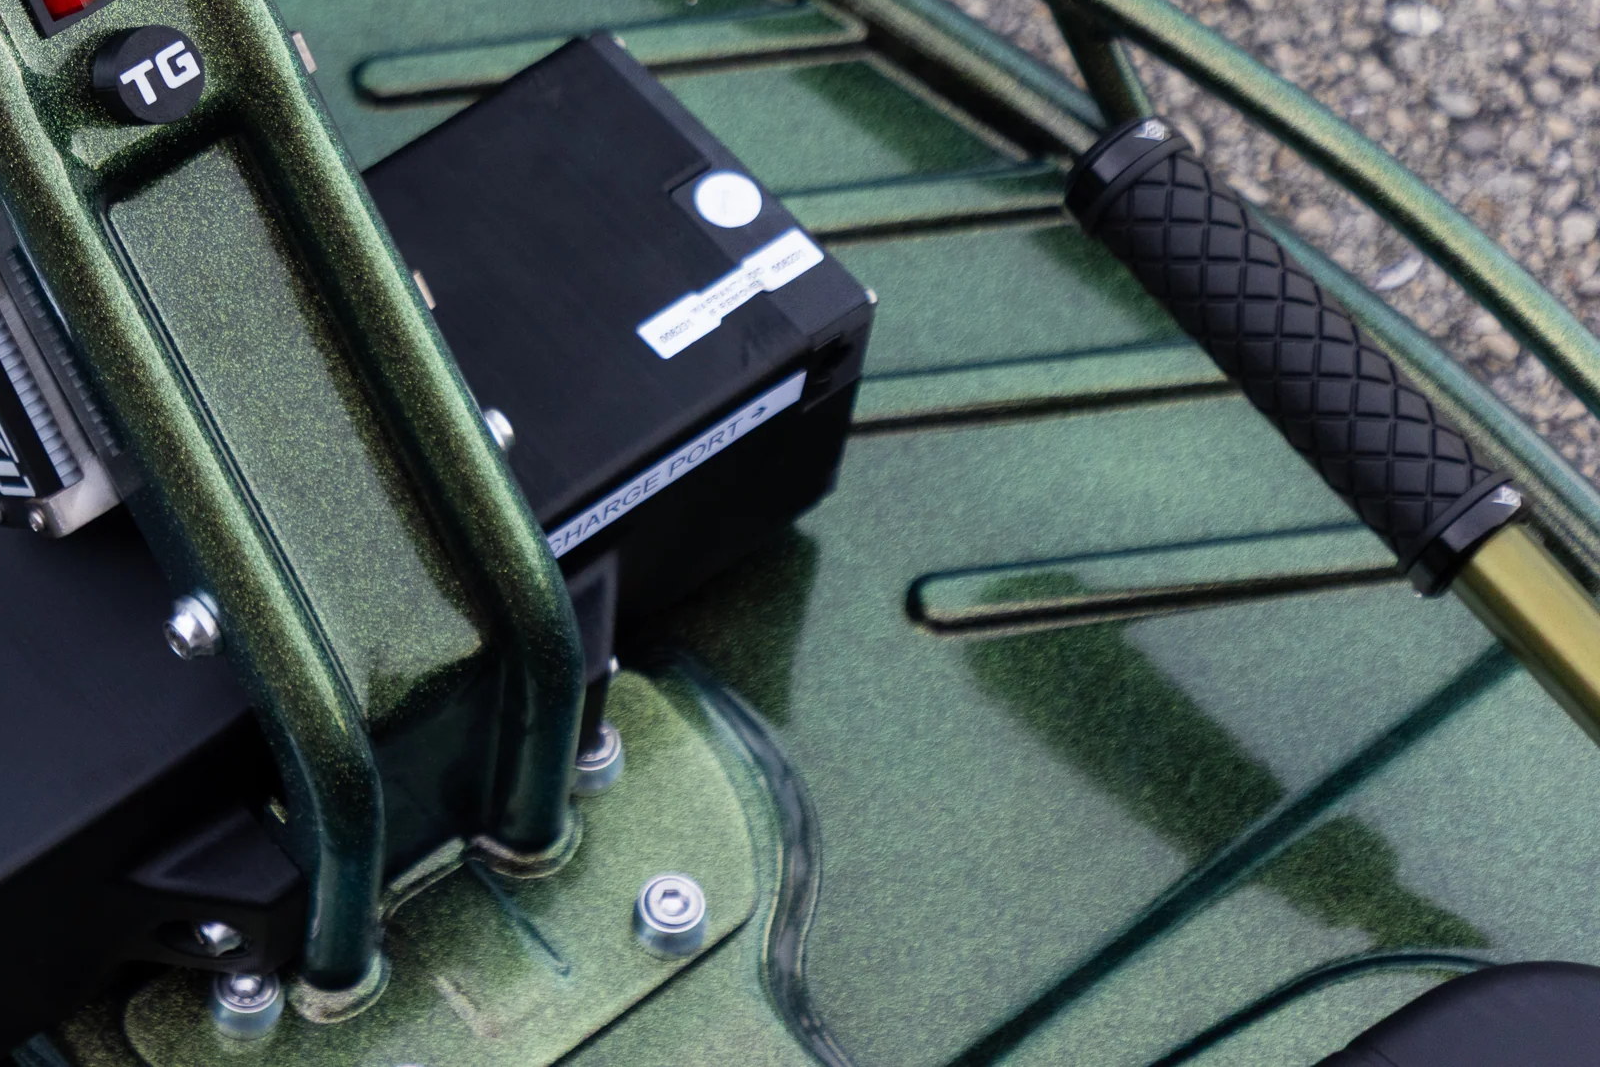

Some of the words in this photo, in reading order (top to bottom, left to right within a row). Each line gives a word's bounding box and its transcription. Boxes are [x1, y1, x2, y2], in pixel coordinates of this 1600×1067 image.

[119, 40, 201, 106] TG
[549, 470, 660, 556] CHARGE
[668, 417, 744, 479] PORT
